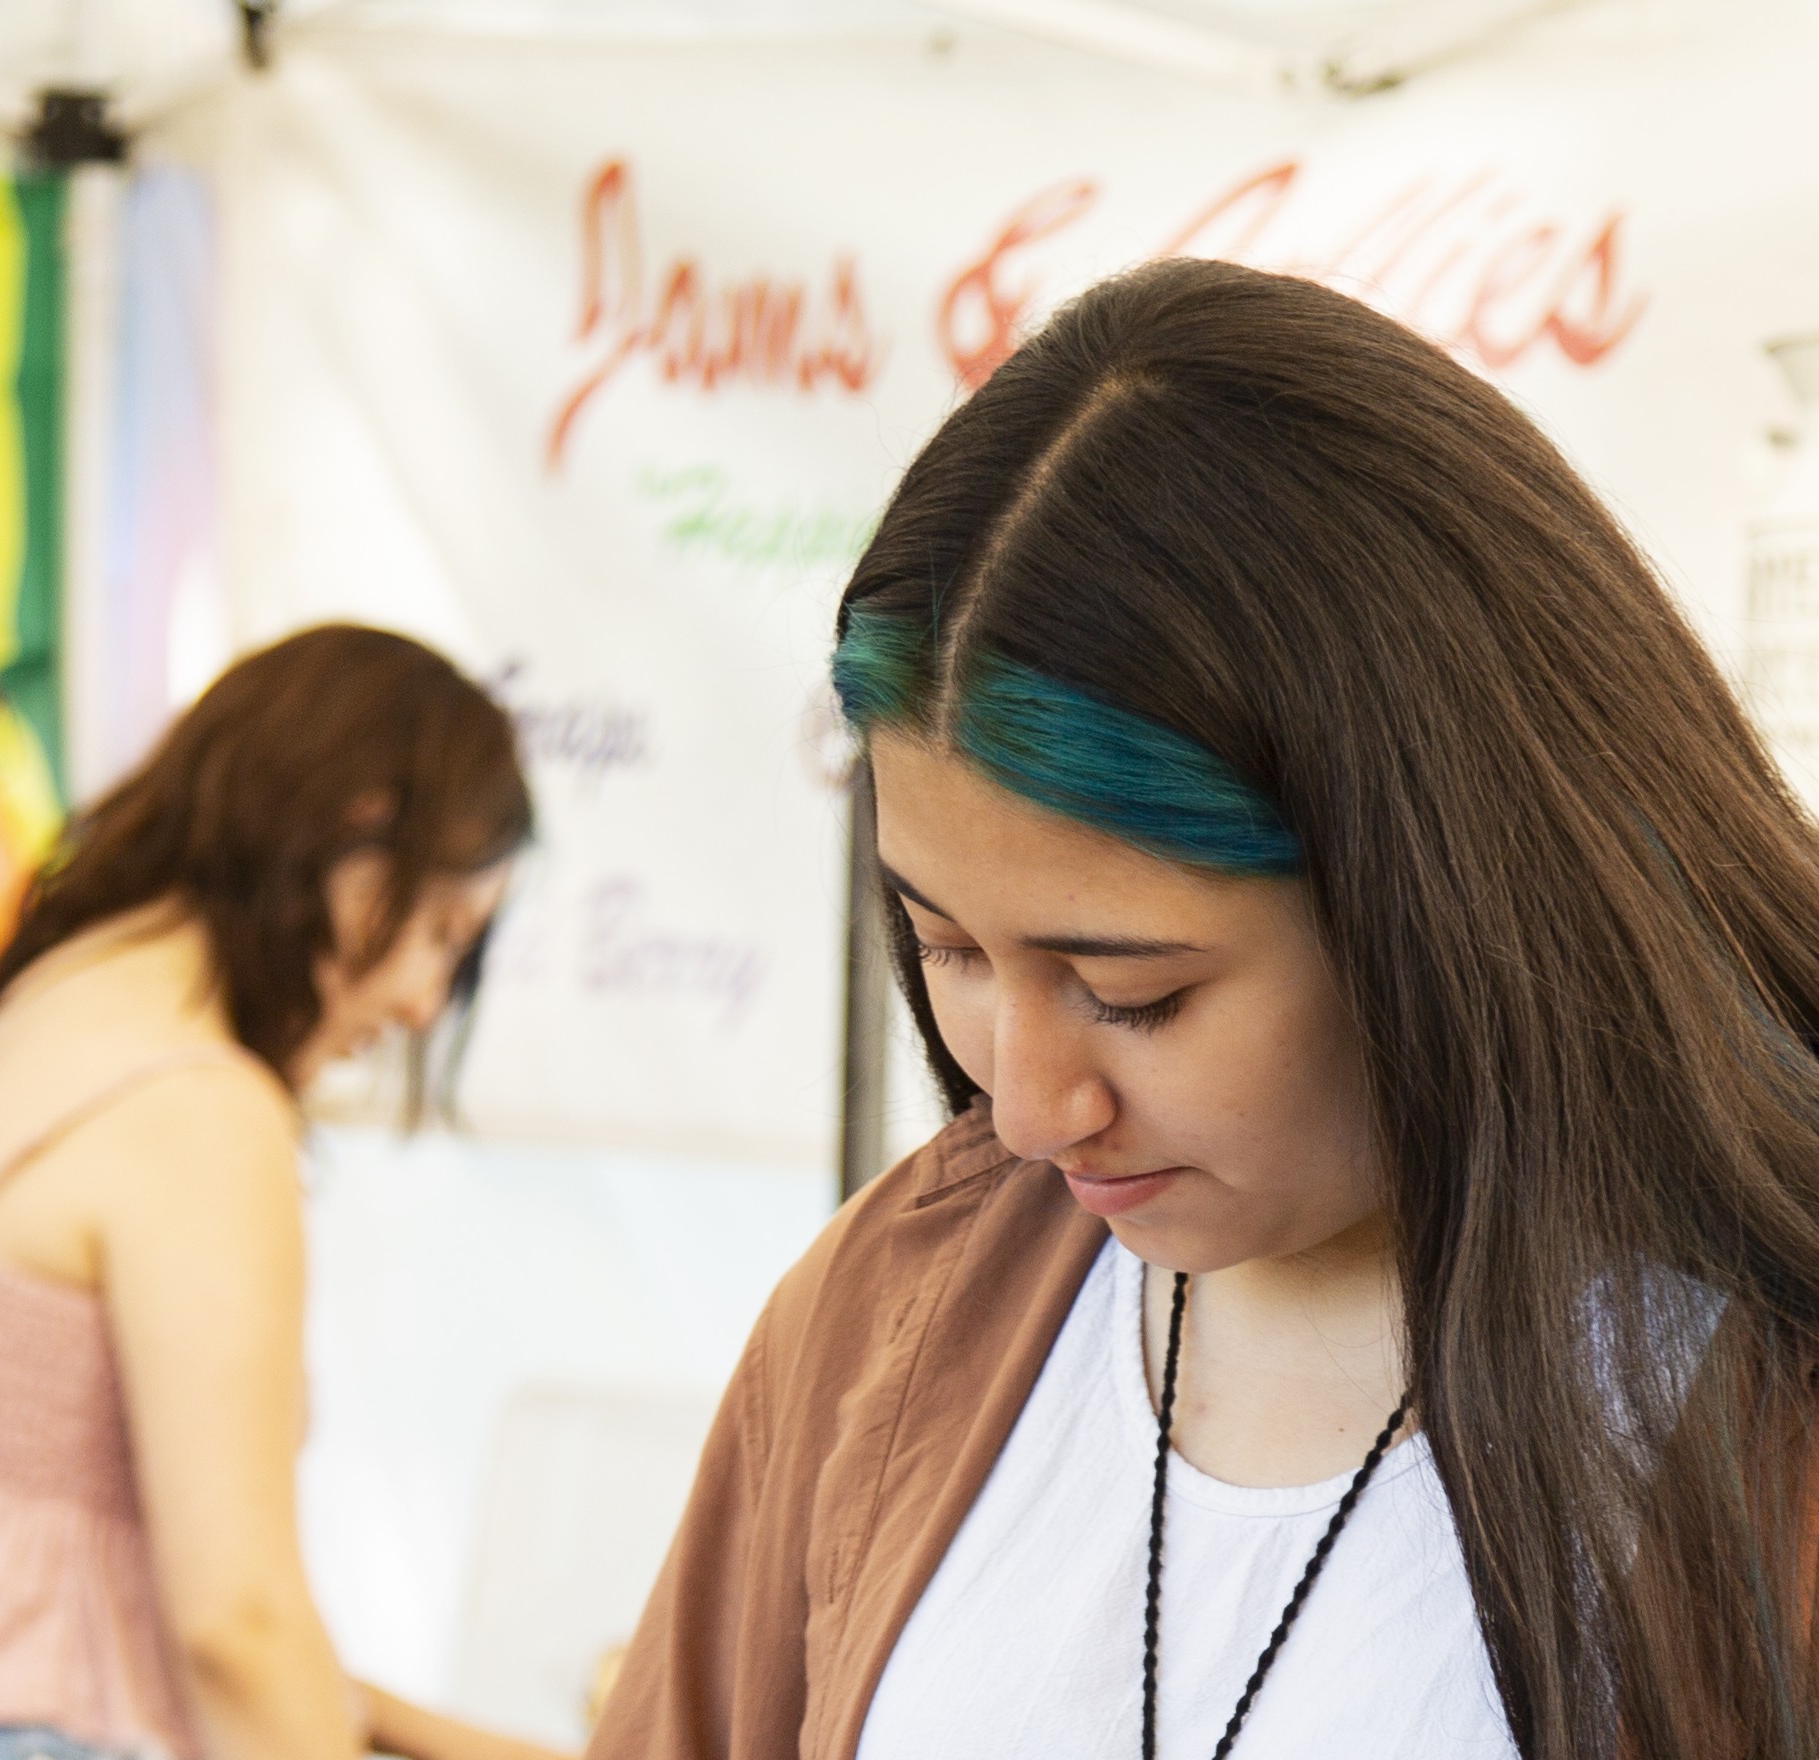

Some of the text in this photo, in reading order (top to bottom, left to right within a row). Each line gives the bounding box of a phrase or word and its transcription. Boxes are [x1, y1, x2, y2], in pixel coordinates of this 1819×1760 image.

[544, 150, 1656, 480] Jams & llies
